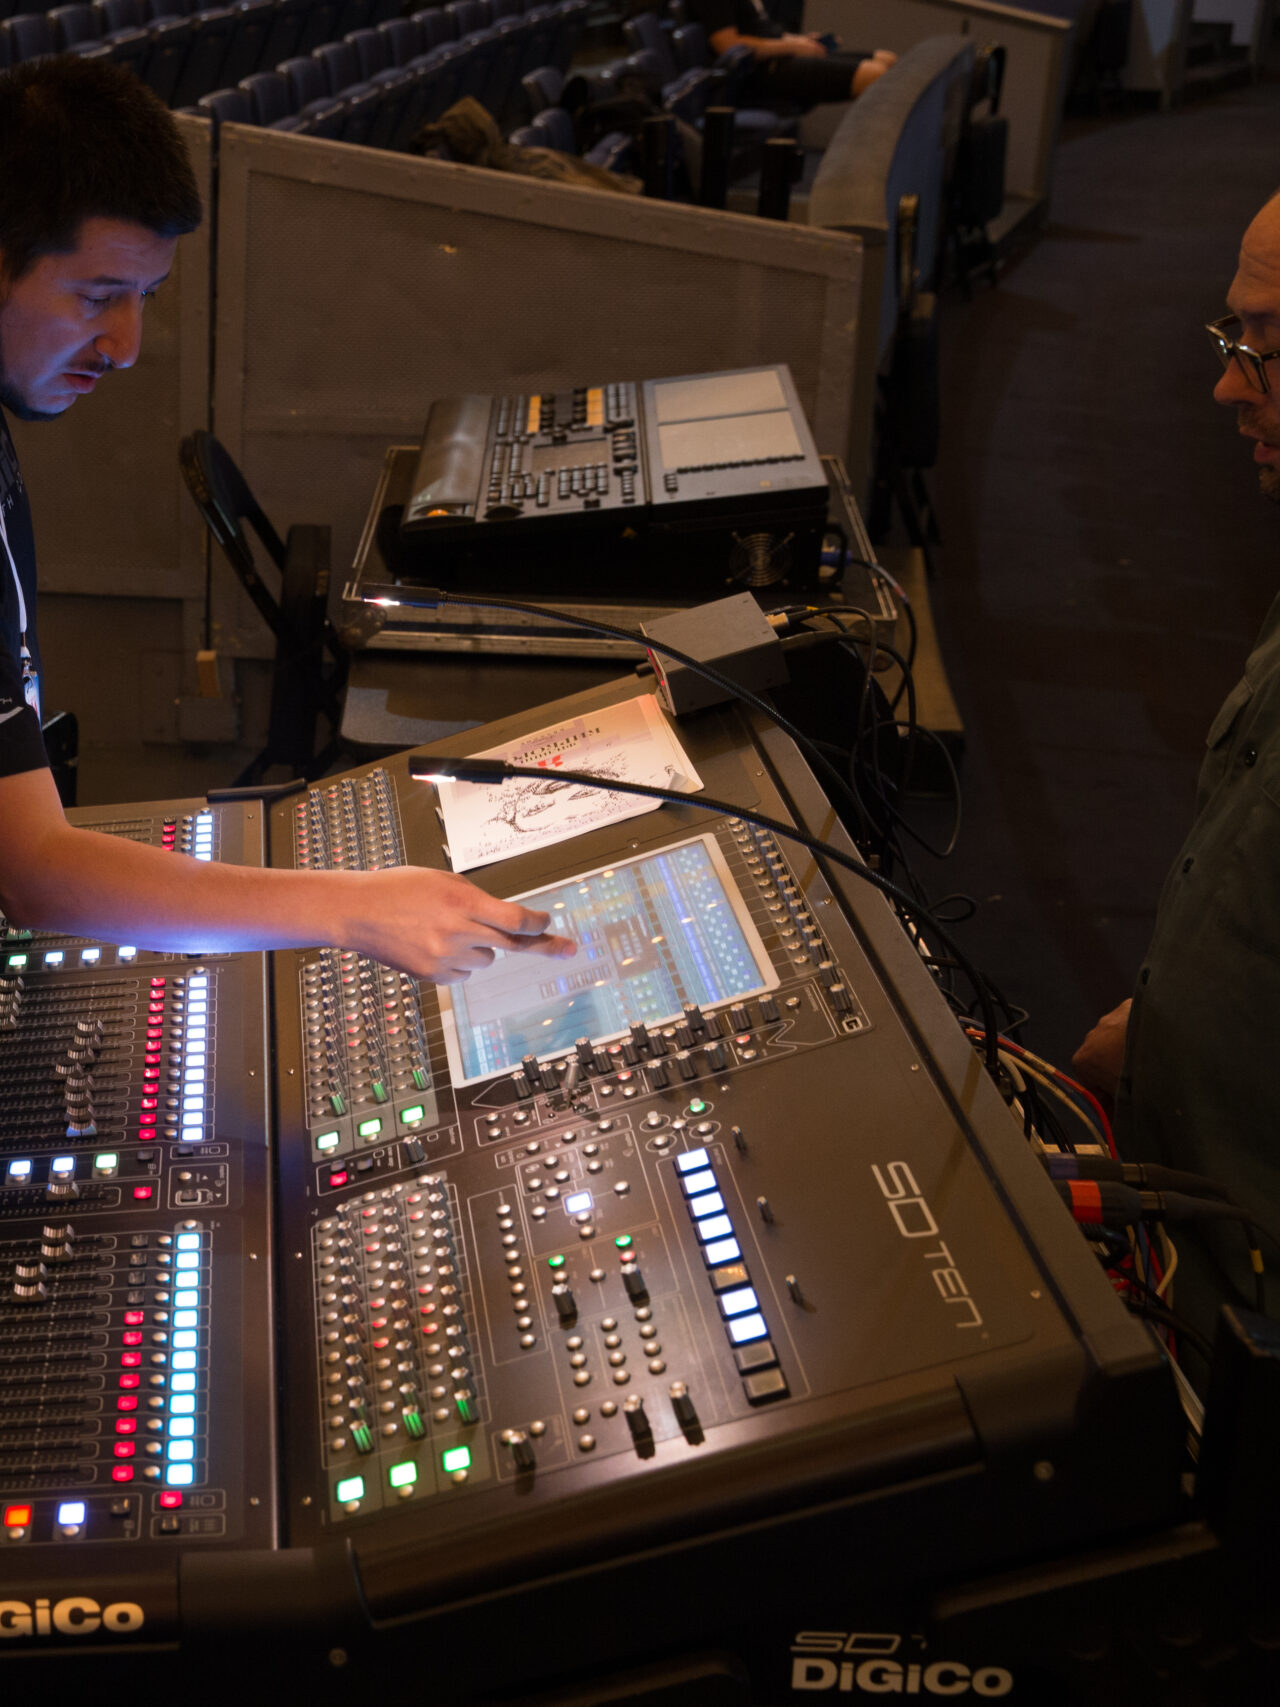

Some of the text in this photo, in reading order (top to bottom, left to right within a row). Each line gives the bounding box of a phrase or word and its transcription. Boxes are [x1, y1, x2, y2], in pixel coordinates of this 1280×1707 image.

[870, 1160, 983, 1328] SD TEN
[789, 1630, 903, 1655] SD
[790, 1656, 1015, 1699] DiGiCo
